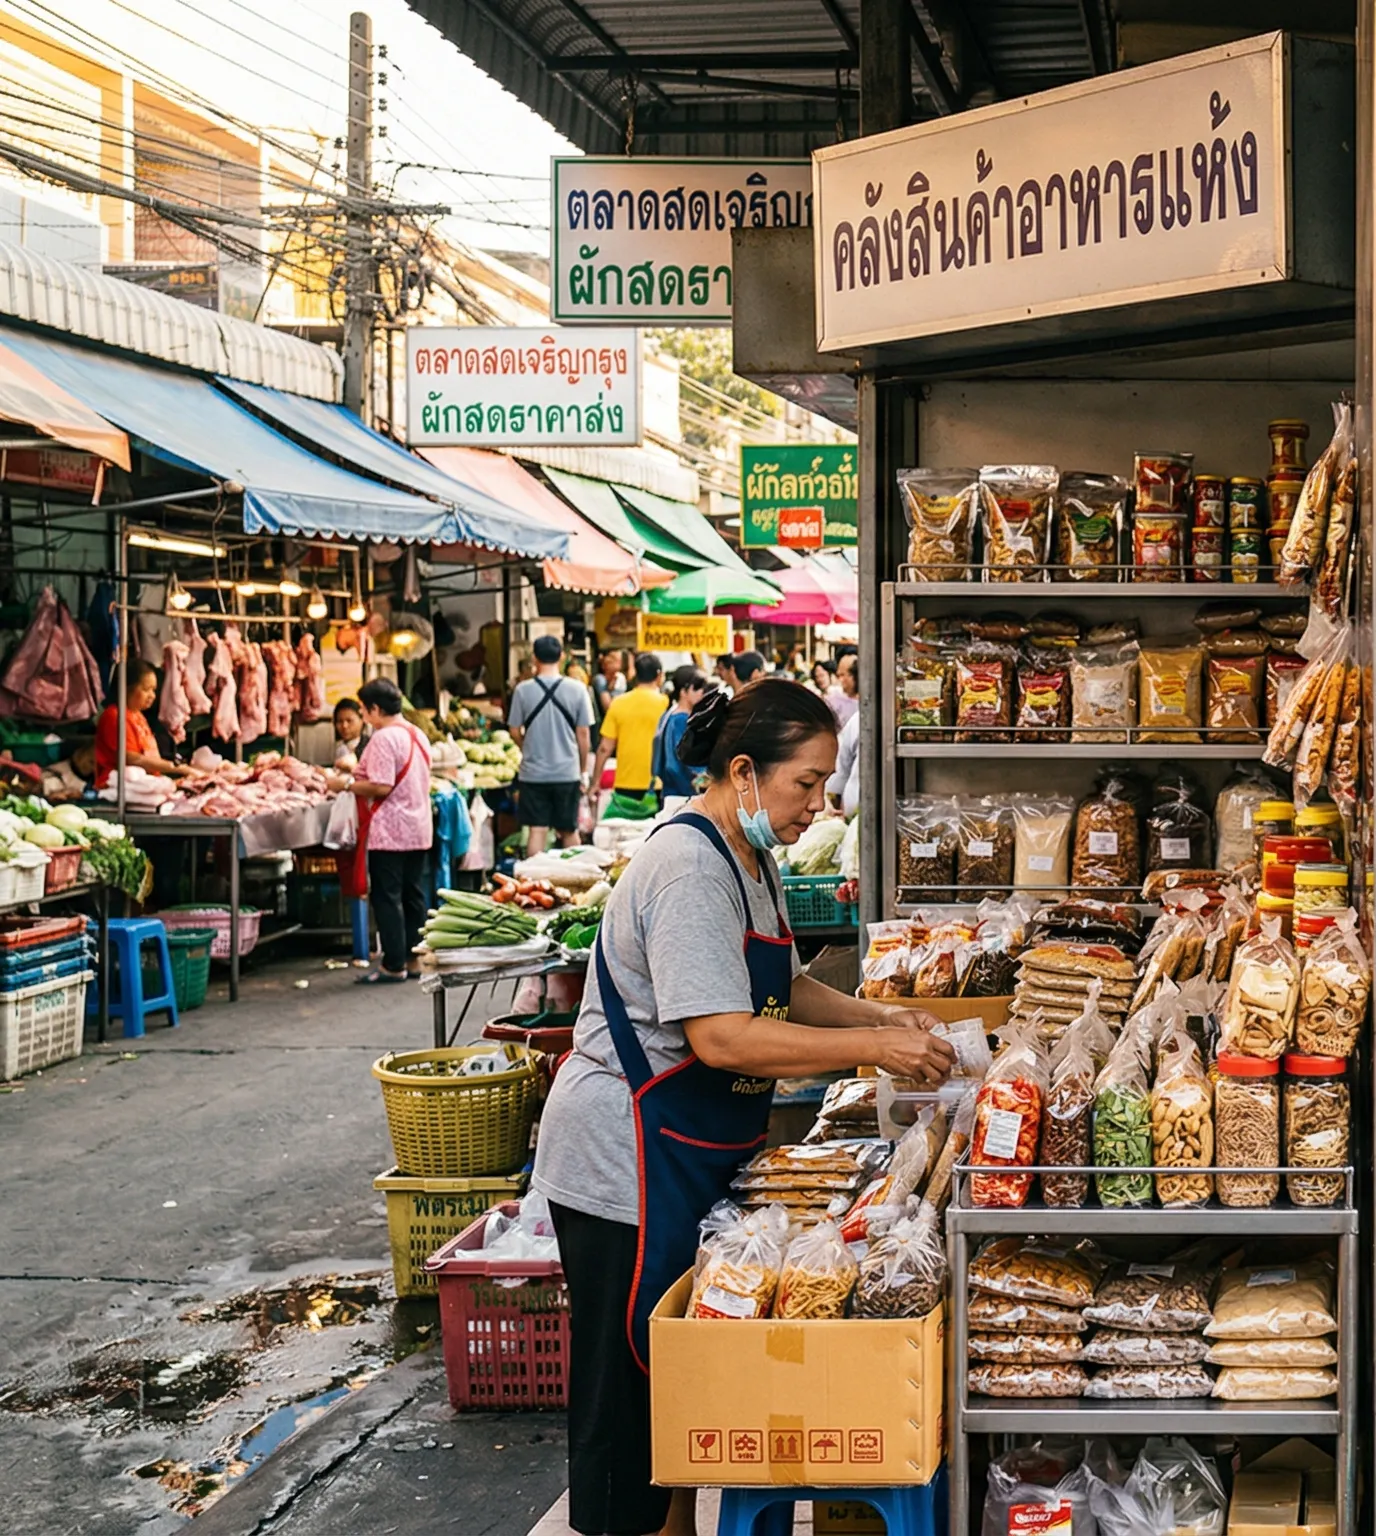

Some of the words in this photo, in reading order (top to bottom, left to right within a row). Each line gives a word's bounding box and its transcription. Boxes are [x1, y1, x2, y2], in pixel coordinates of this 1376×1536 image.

[832, 90, 1259, 293] คลังสินค้าอาหารแห้ง
[415, 335, 628, 390] ตลาดสดเจริญกรุง
[421, 391, 625, 434] ผักสดราคาส่ง
